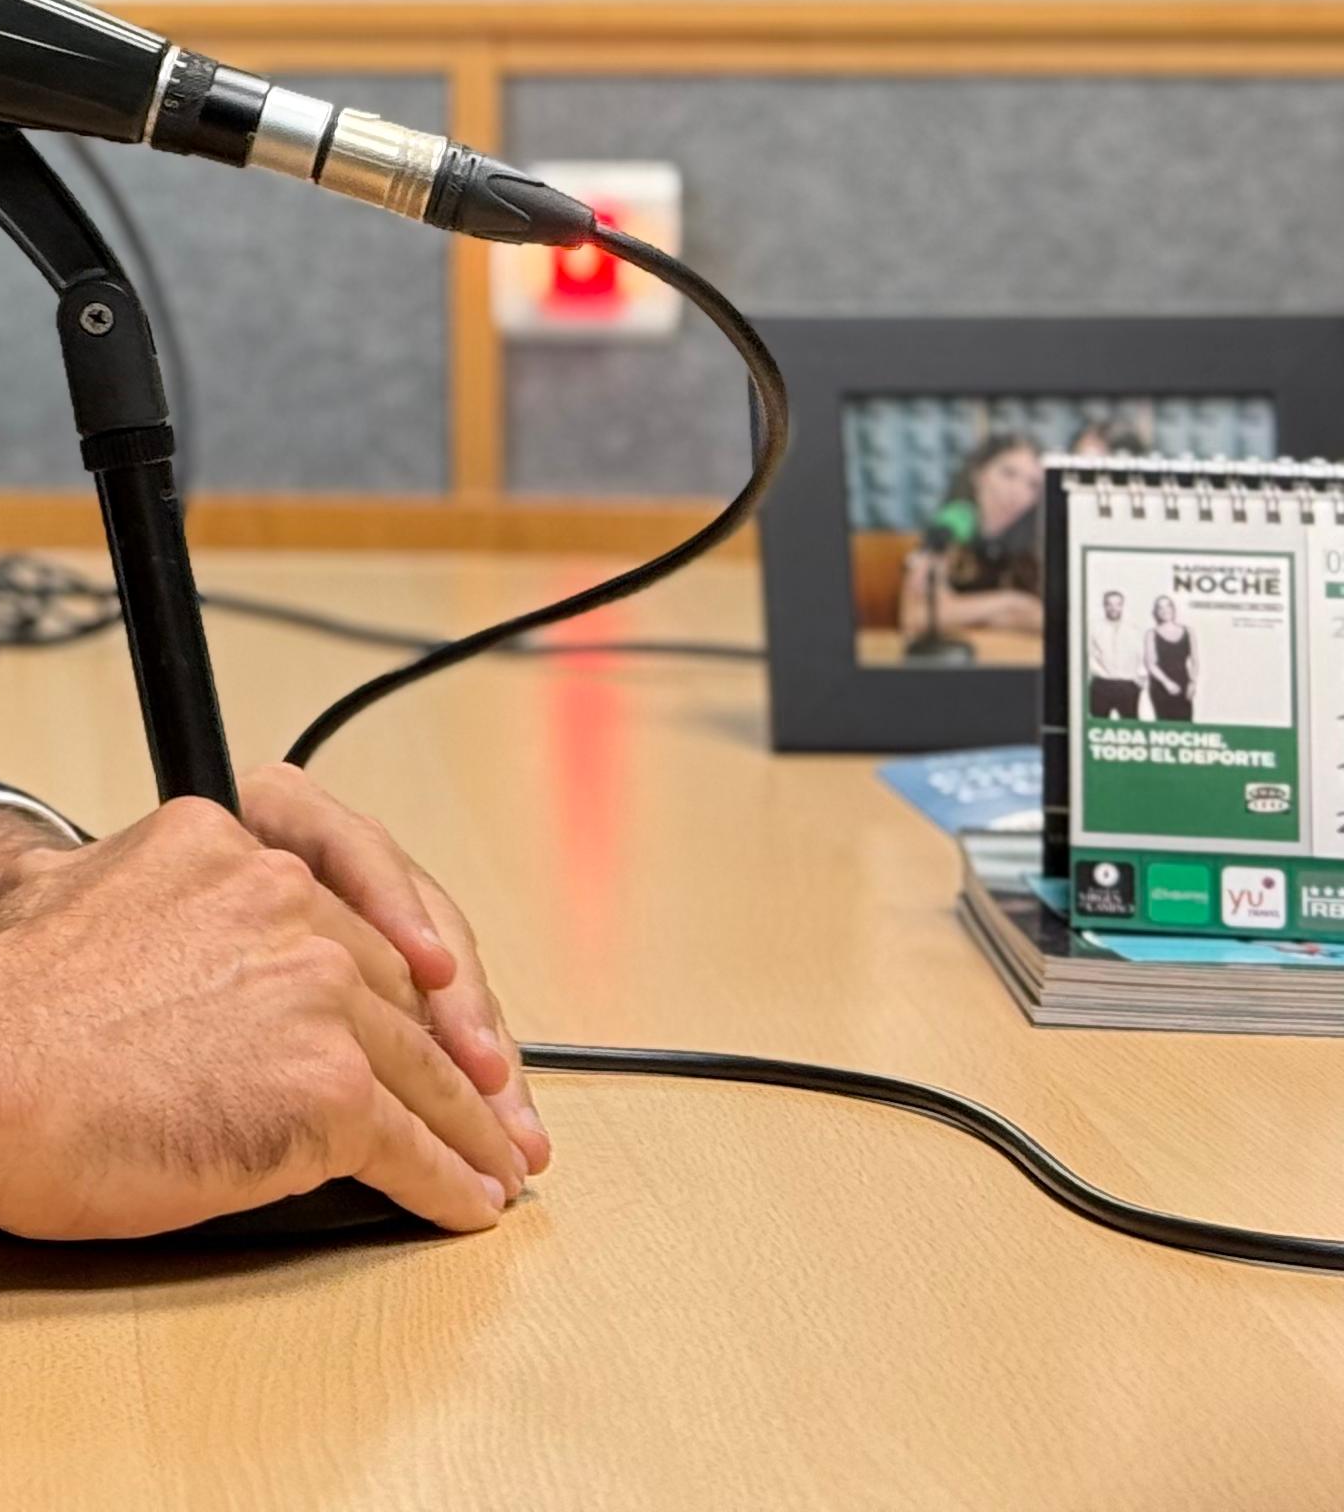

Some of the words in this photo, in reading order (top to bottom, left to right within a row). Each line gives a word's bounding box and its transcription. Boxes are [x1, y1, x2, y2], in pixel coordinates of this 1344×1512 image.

[1173, 574, 1281, 596] NOCHE
[1087, 727, 1147, 745] CADA
[1089, 744, 1148, 762] TODO
[1150, 747, 1176, 764] EL
[1178, 748, 1277, 768] DEPORTE
[1226, 889, 1263, 915] yu
